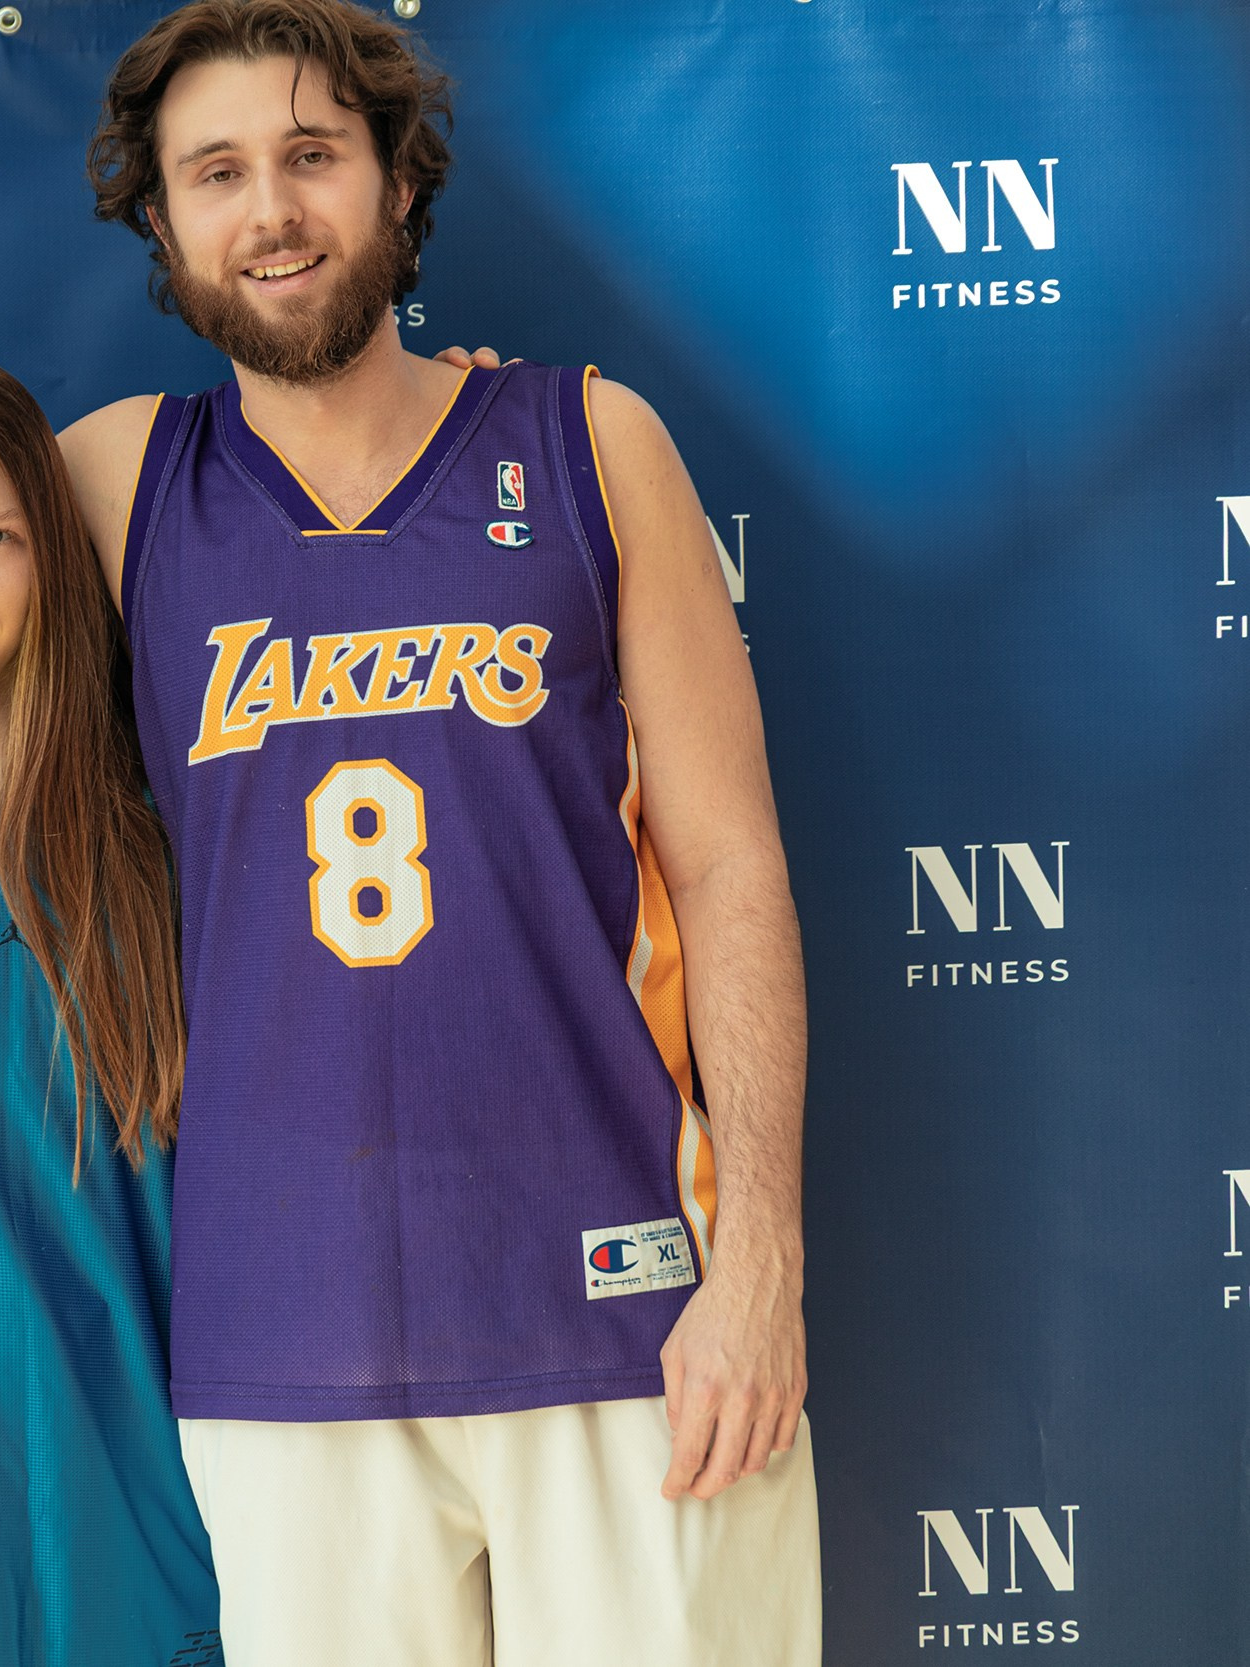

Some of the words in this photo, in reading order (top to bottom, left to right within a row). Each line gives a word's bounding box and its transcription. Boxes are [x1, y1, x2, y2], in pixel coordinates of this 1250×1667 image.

[890, 158, 1059, 256] NN
[892, 279, 1061, 310] FITNESS
[188, 617, 553, 766] LAKERS
[305, 758, 435, 969] 8
[905, 841, 1069, 935] NN
[907, 958, 1069, 988] FITNESS
[657, 1243, 680, 1263] XL
[916, 1505, 1079, 1597] NN
[918, 1619, 1080, 1648] FITNESS
